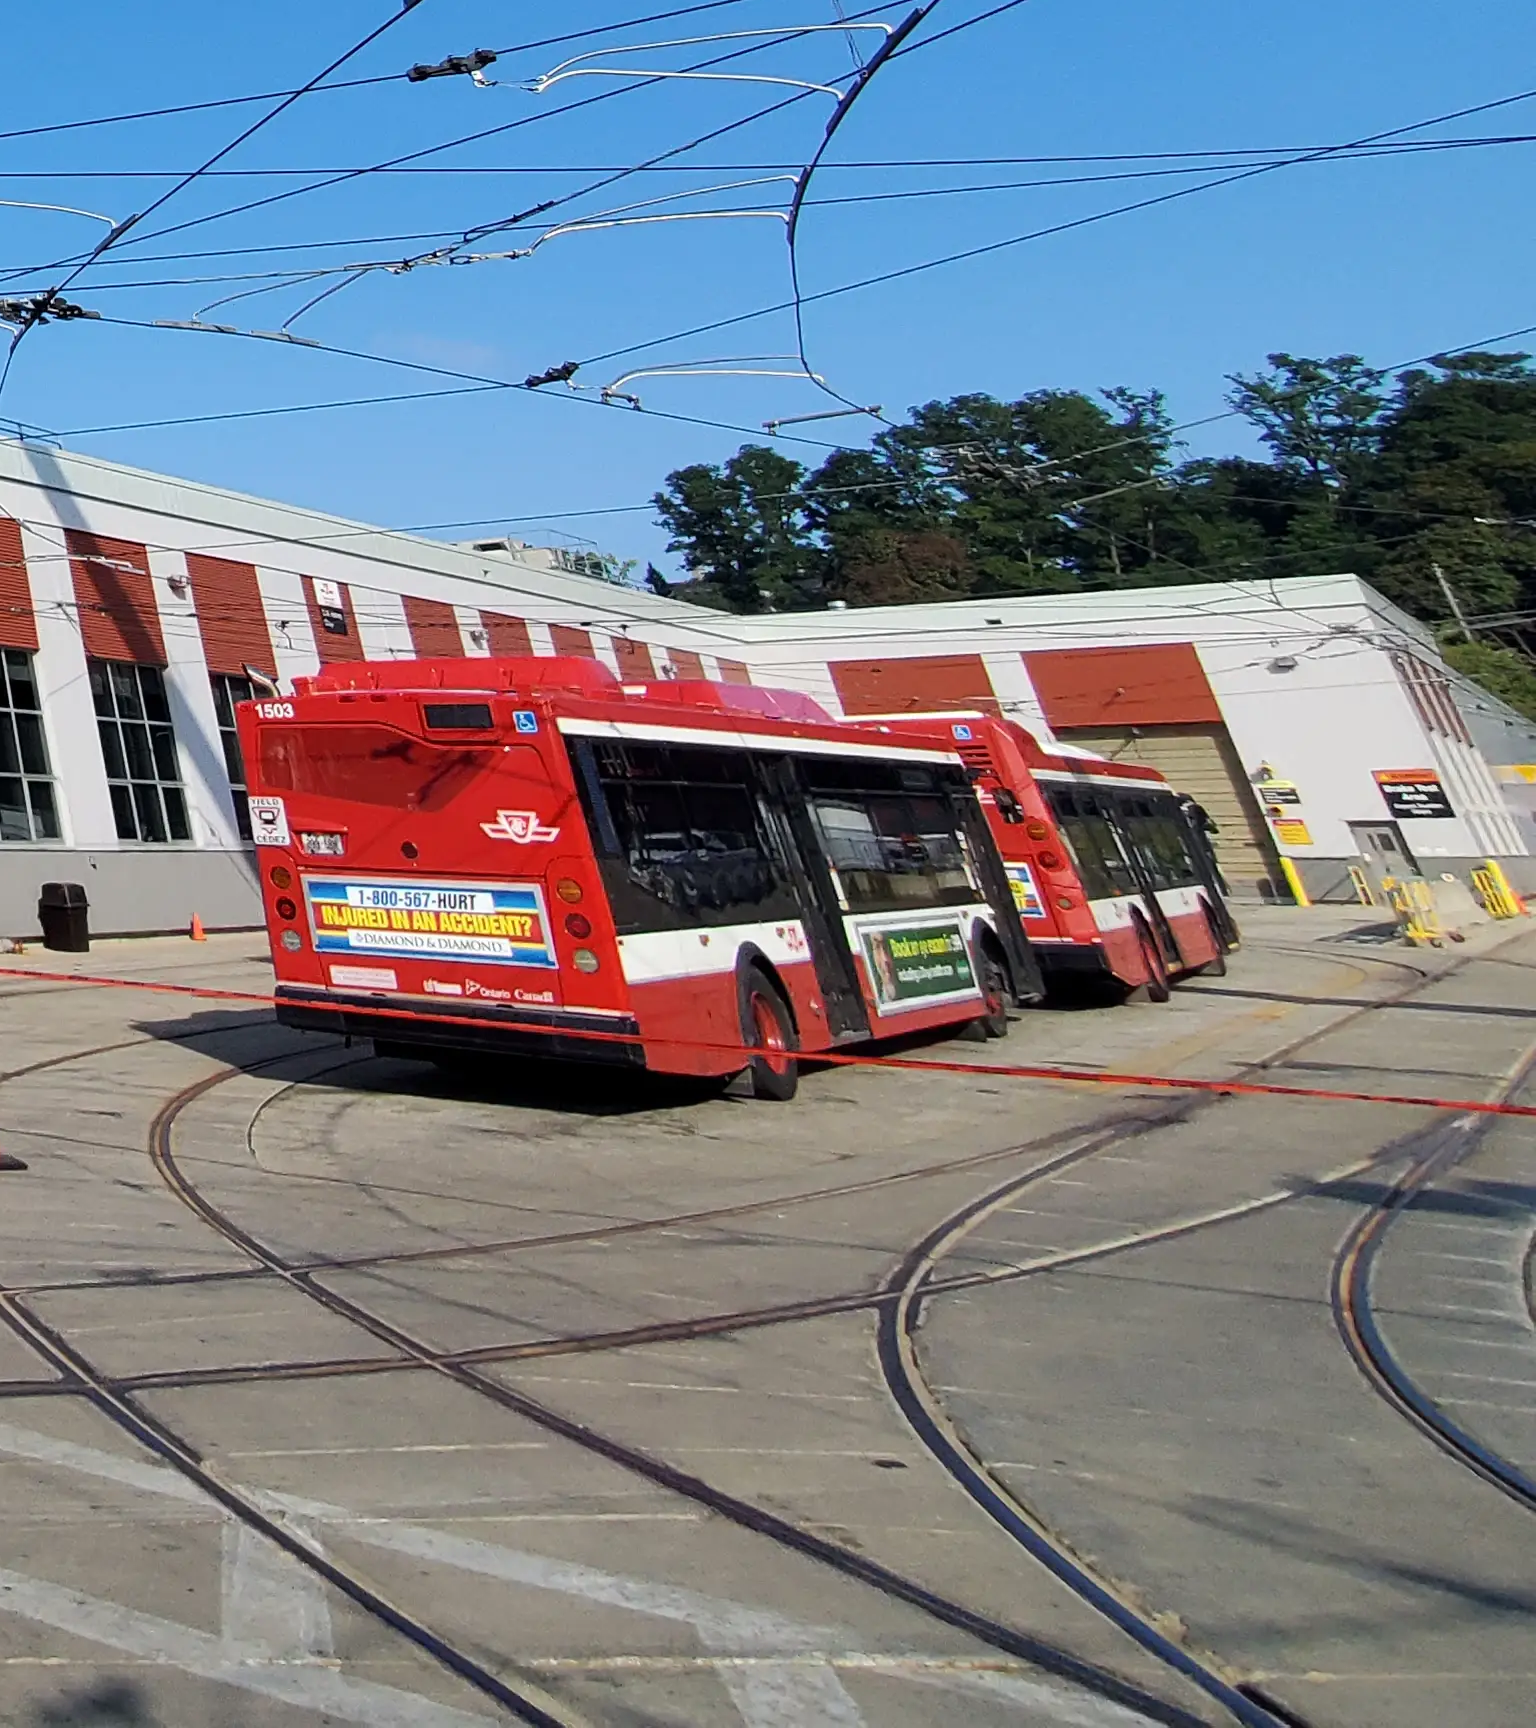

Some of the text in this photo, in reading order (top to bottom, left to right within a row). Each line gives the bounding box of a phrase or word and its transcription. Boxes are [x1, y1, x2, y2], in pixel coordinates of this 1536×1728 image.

[254, 702, 295, 719] 1503
[251, 798, 279, 807] YIELD
[358, 889, 477, 911] 1-800-567-HURT
[321, 905, 533, 937] INJURED IN AN ACCIDENT?
[364, 933, 503, 954] DIAMOND & DIAMOND
